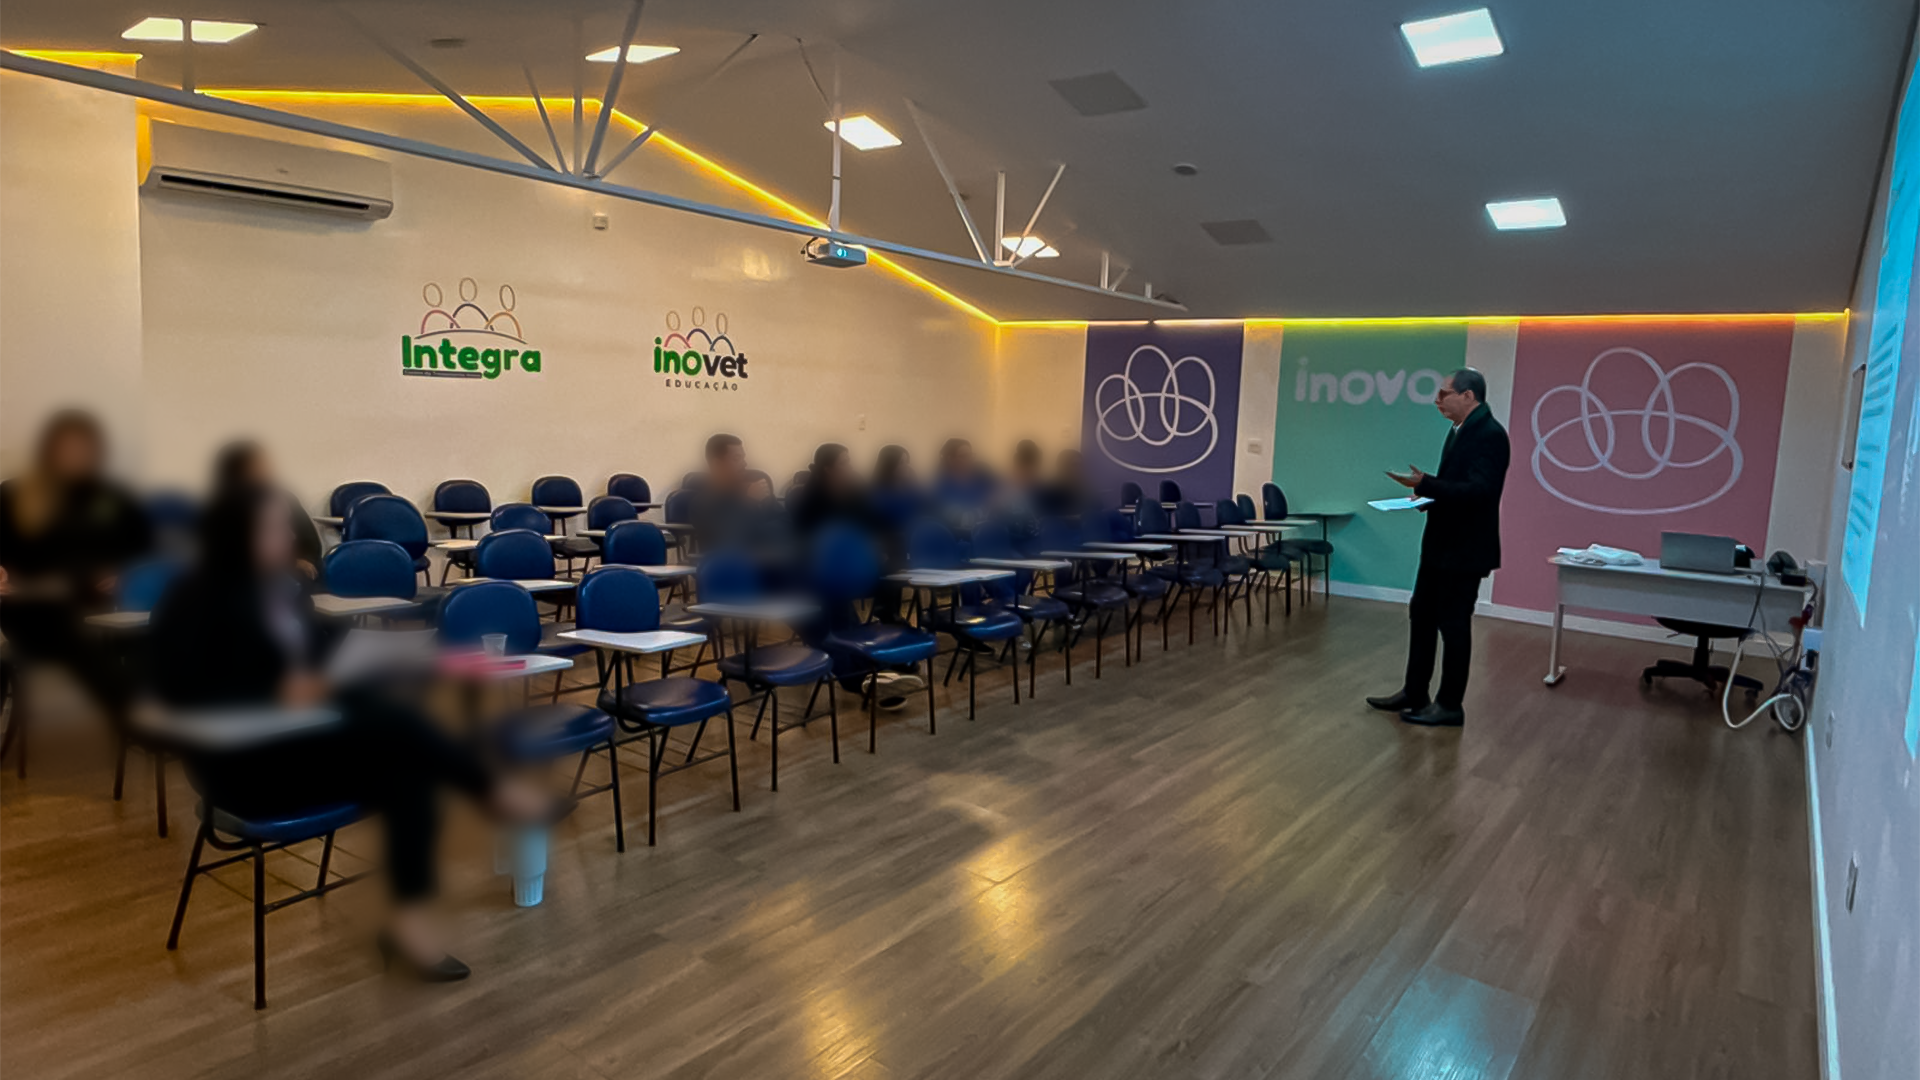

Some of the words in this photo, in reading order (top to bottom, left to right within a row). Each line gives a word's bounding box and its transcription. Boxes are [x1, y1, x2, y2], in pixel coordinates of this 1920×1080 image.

[402, 335, 541, 379] Integra
[653, 336, 748, 379] inovet
[665, 379, 738, 391] EDUCAÇÃO
